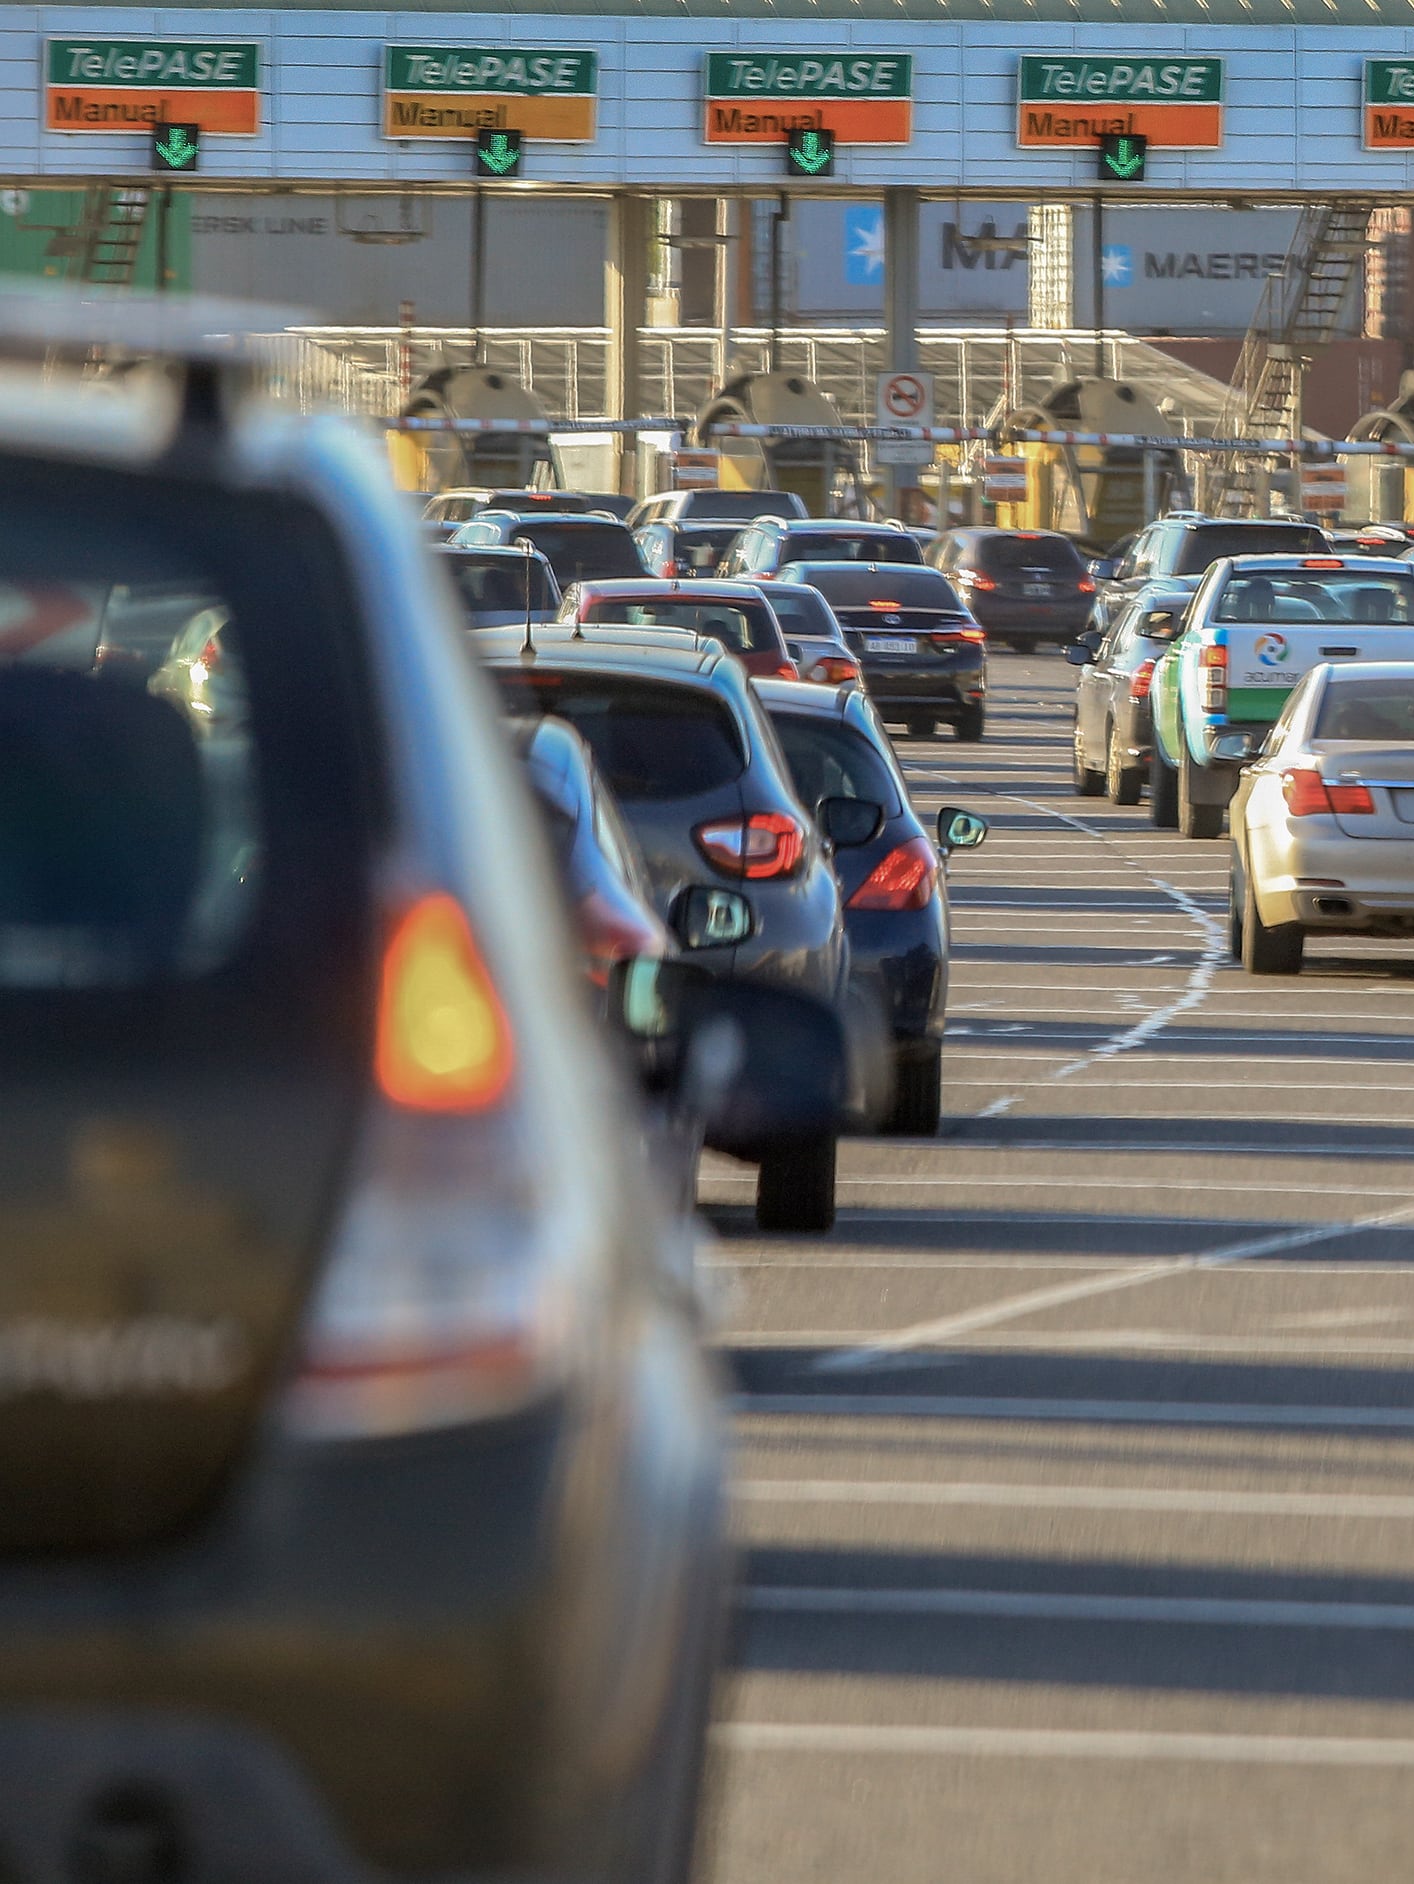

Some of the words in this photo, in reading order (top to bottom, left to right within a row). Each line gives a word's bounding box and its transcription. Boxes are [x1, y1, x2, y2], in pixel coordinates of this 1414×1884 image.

[66, 47, 245, 80] TelePASE
[406, 54, 577, 88] TelePASE
[727, 59, 899, 91] TelePASE
[1040, 64, 1209, 96] TelePASE
[55, 96, 169, 122] Manual
[391, 101, 506, 126] Manual
[715, 108, 823, 132] Manual
[1027, 112, 1134, 136] Manual
